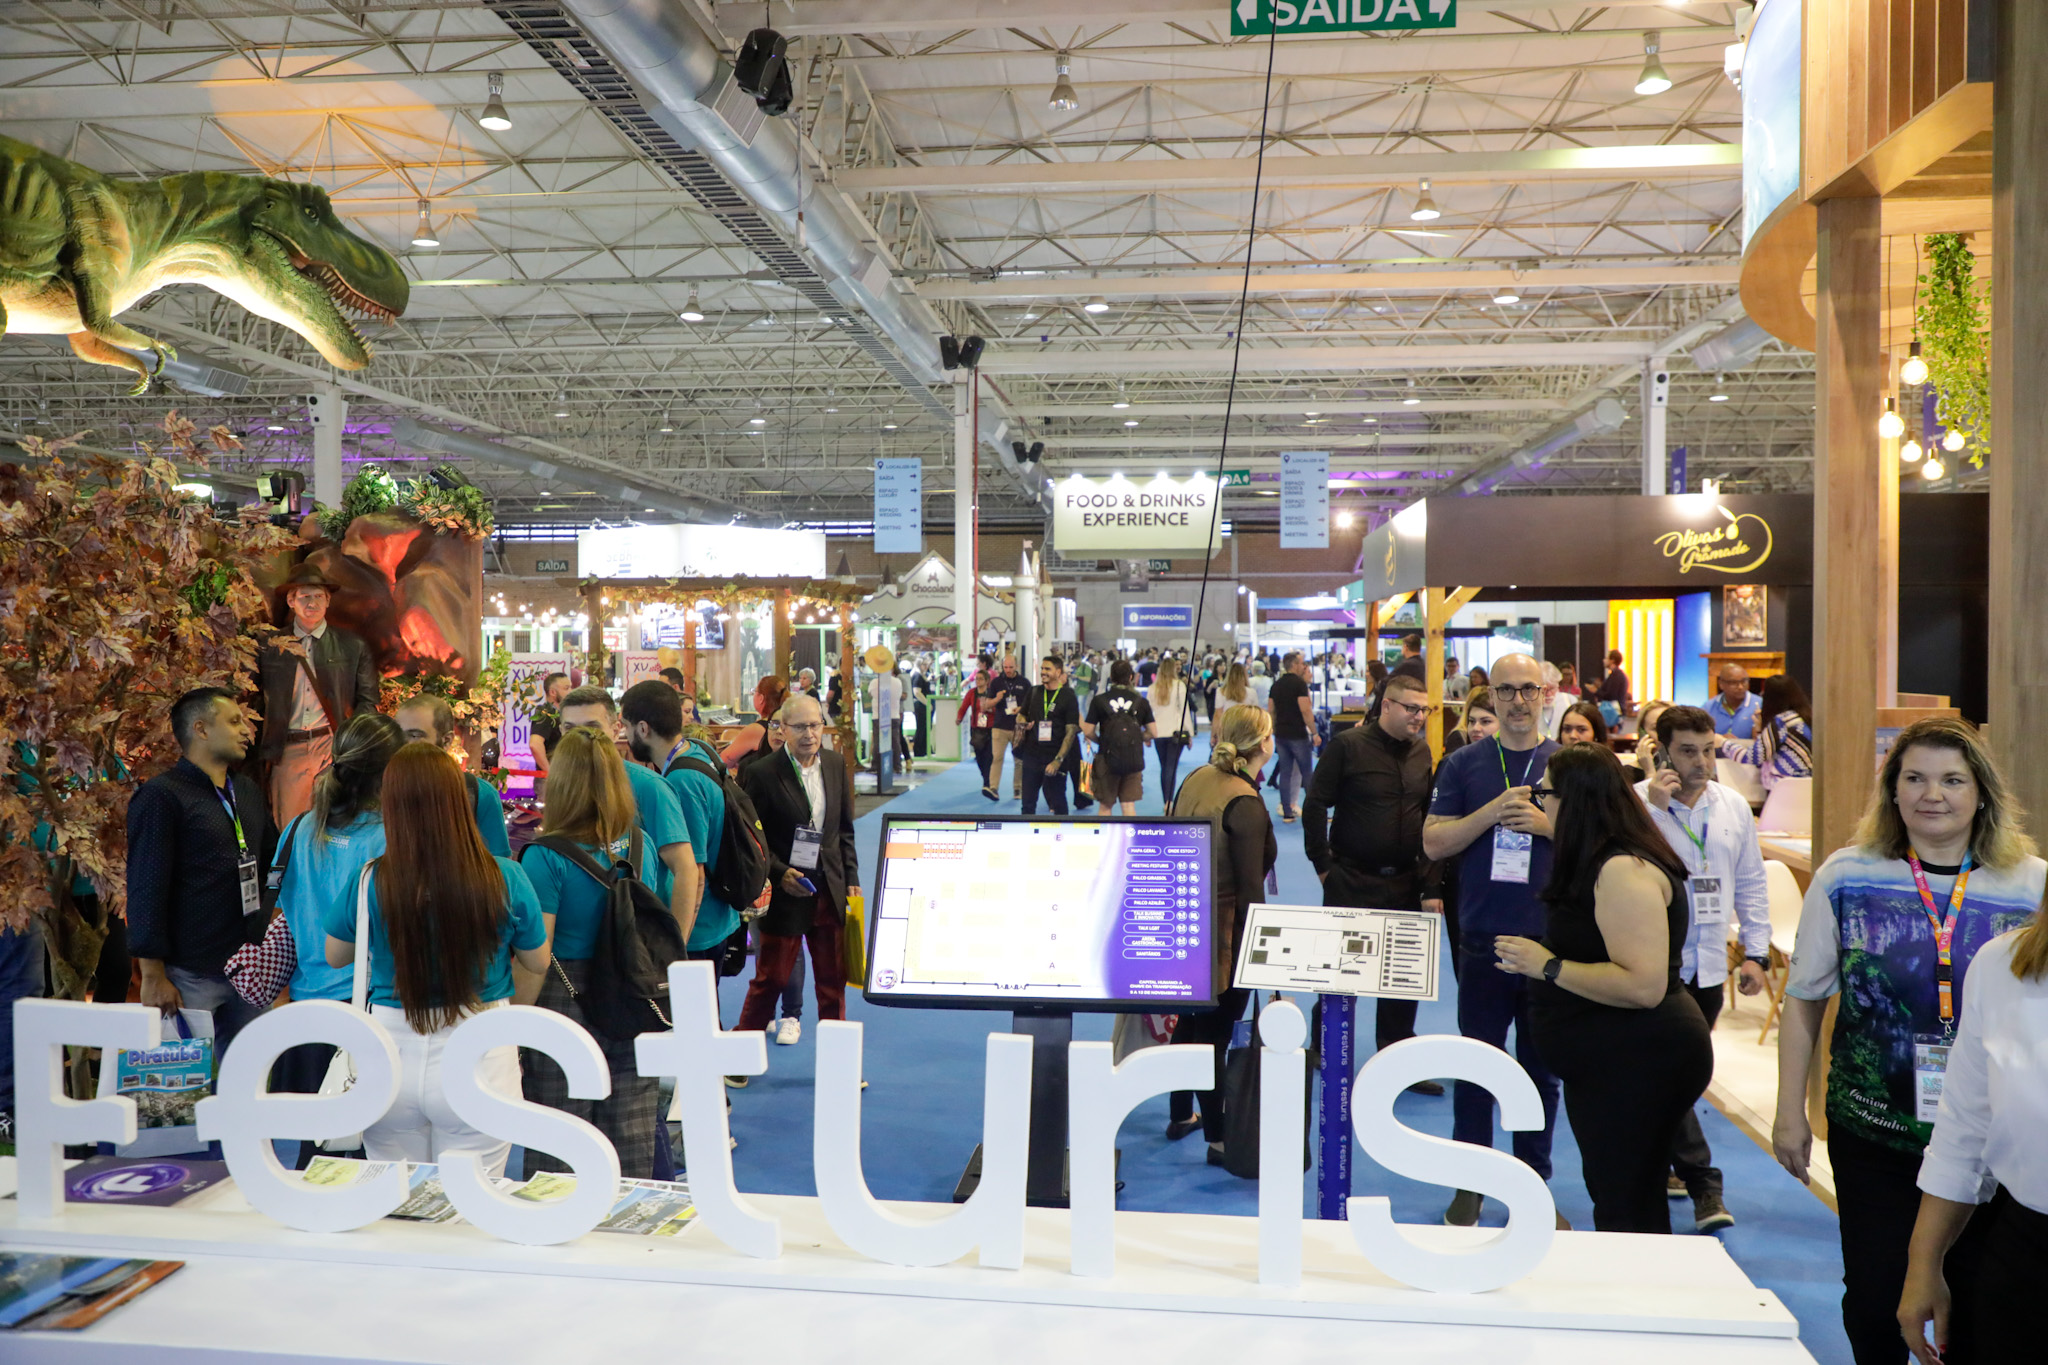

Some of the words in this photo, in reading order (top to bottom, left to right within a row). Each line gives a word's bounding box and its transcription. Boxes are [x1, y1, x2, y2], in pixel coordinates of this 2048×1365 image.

[1066, 494, 1118, 508] FOOD
[1123, 494, 1135, 508] &
[1140, 493, 1206, 507] DRINKS
[1083, 512, 1189, 527] EXPERIENCE
[1679, 539, 1751, 574] Gramado
[537, 559, 567, 571] SAÍDA
[911, 583, 955, 593] Chocoland
[1140, 614, 1186, 622] INFORMAÇÕES
[1188, 827, 1206, 839] 35
[1940, 934, 1949, 945] FLY
[1341, 1030, 1349, 1066] Festuris
[127, 1046, 203, 1067] Piratuba
[1340, 1086, 1348, 1122] Festuris
[12, 960, 1557, 1295] Festuris
[1339, 1142, 1347, 1179] Festuris
